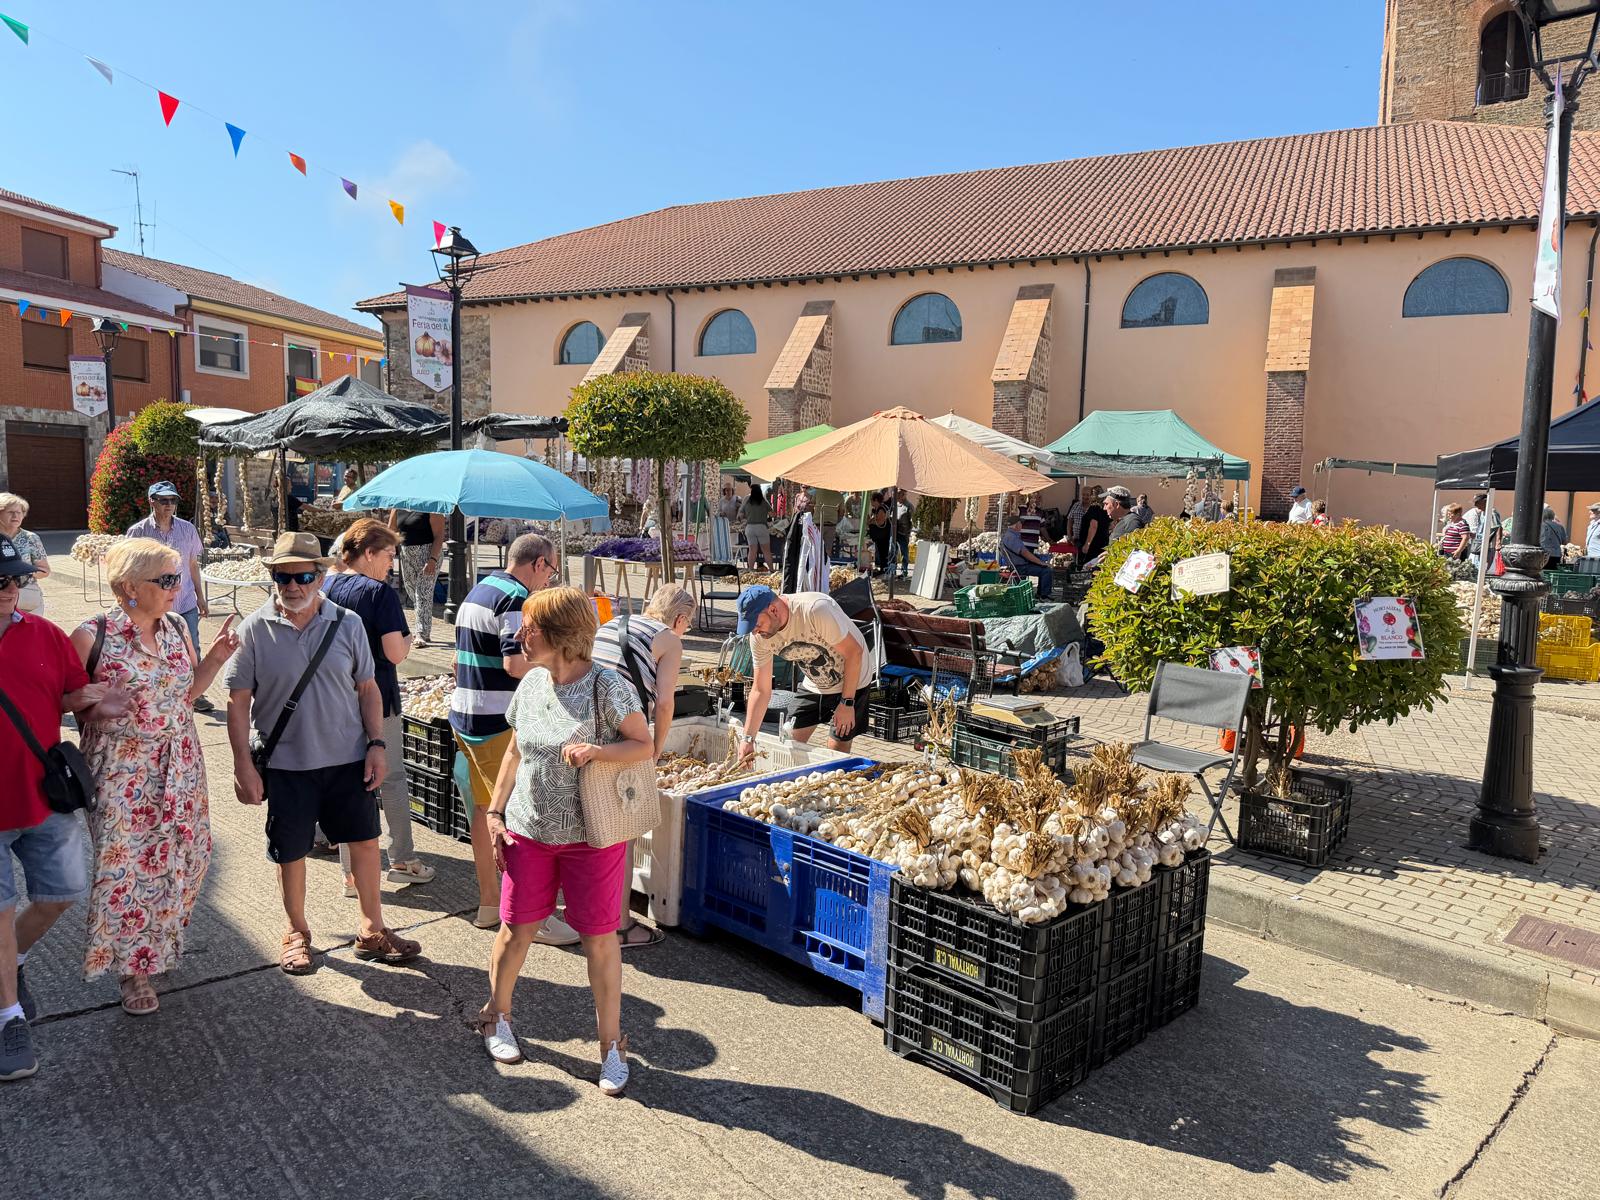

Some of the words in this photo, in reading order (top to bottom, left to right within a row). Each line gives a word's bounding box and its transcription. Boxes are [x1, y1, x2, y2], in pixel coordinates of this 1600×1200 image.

[412, 319, 431, 330] Feria
[431, 323, 442, 331] del
[1373, 605, 1402, 613] HORTALIZAS
[948, 953, 979, 980] HORTYVAL
[944, 1042, 975, 1069] HORTYVAL
